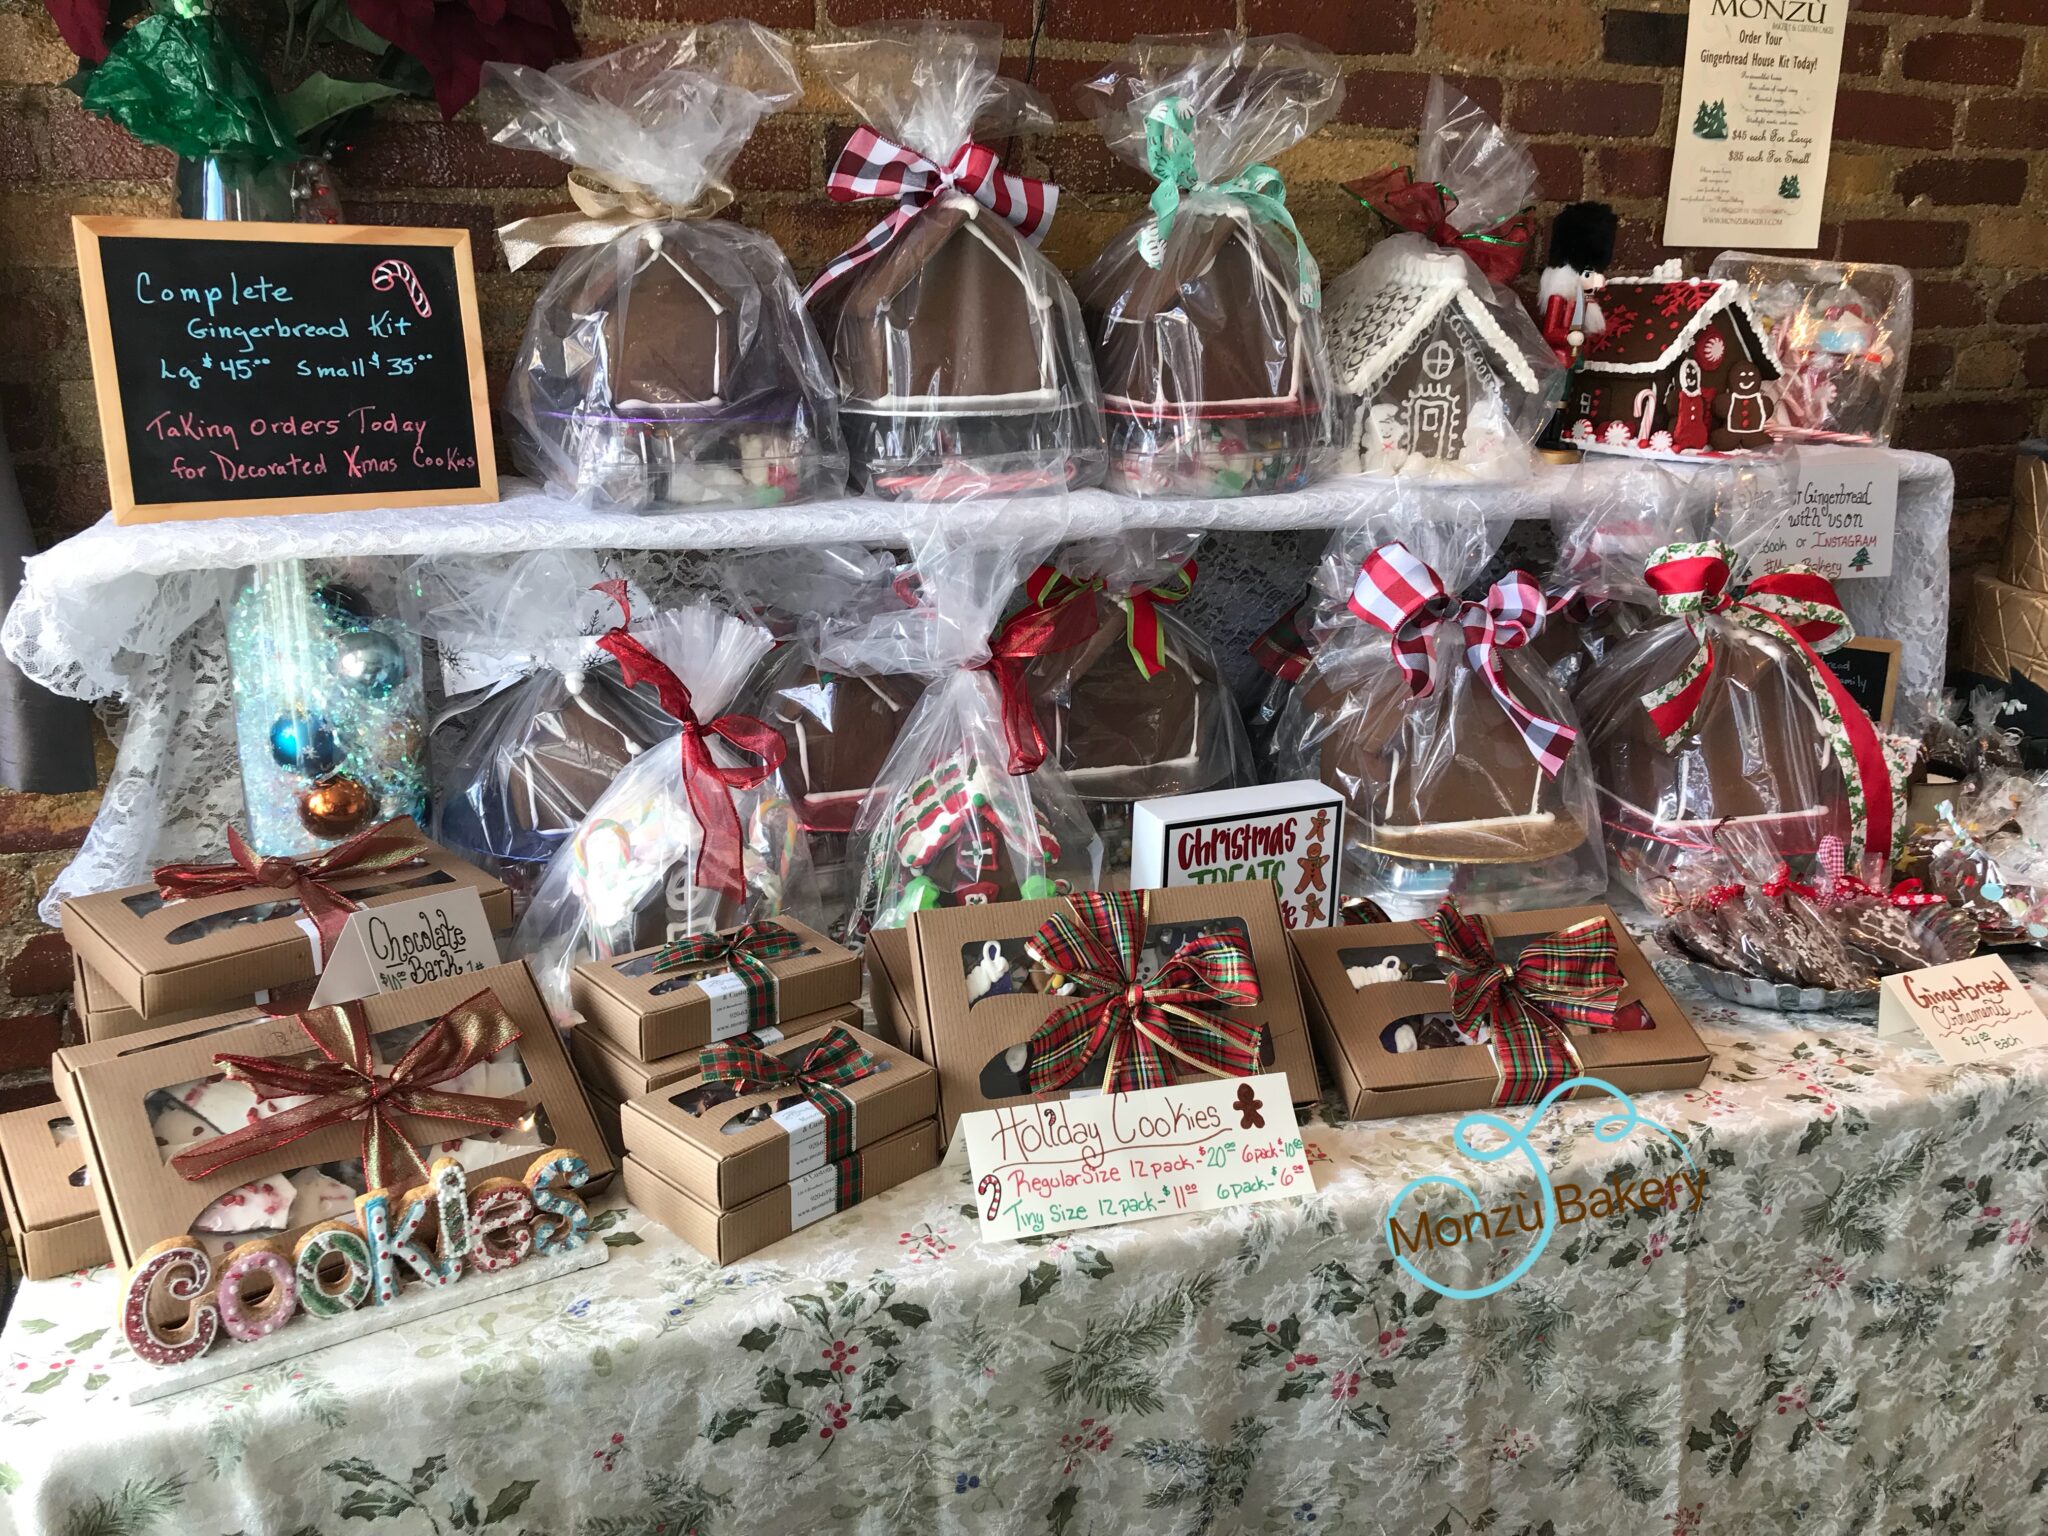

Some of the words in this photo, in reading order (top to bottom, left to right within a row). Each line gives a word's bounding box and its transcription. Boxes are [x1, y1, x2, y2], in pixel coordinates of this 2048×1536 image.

[1739, 29, 1761, 44] Order
[1765, 31, 1782, 46] Your
[1700, 49, 1748, 67] Gingerbread
[1752, 52, 1775, 67] House
[1779, 54, 1789, 68] Kit
[1793, 55, 1818, 74] Today!
[1732, 129, 1747, 140] $45
[1749, 129, 1766, 141] each
[1770, 128, 1785, 143] For
[1788, 129, 1813, 148] Large
[1746, 150, 1763, 162] each
[1766, 149, 1782, 163] For
[1784, 150, 1811, 164] Small
[137, 271, 294, 317] Complete
[187, 317, 350, 352] Gingerbread
[368, 310, 412, 338] Kit
[161, 359, 202, 389] Lg
[297, 360, 365, 377] Small
[347, 406, 428, 446] Today
[170, 457, 206, 480] for
[210, 450, 327, 482] Decorated
[1803, 481, 1873, 518] Gingerbread
[1788, 506, 1822, 529] with
[1795, 538, 1807, 549] or
[1810, 531, 1877, 549] INSTAGRAM
[1177, 817, 1298, 871] Christmas
[368, 908, 467, 963] Chocolate
[408, 949, 463, 984] Bark
[1902, 970, 2012, 1013] Gingerbread
[1931, 993, 2012, 1030] Ornaments
[1994, 1034, 2024, 1050] each
[991, 1100, 1105, 1169] Holiday
[1112, 1091, 1221, 1143] Cookies
[1007, 1169, 1081, 1198] Regular
[1081, 1163, 1121, 1184] Size
[1129, 1159, 1149, 1178] 12
[1003, 1199, 1045, 1233] Tiny
[1050, 1203, 1089, 1223] Size
[1099, 1199, 1118, 1216] 12
